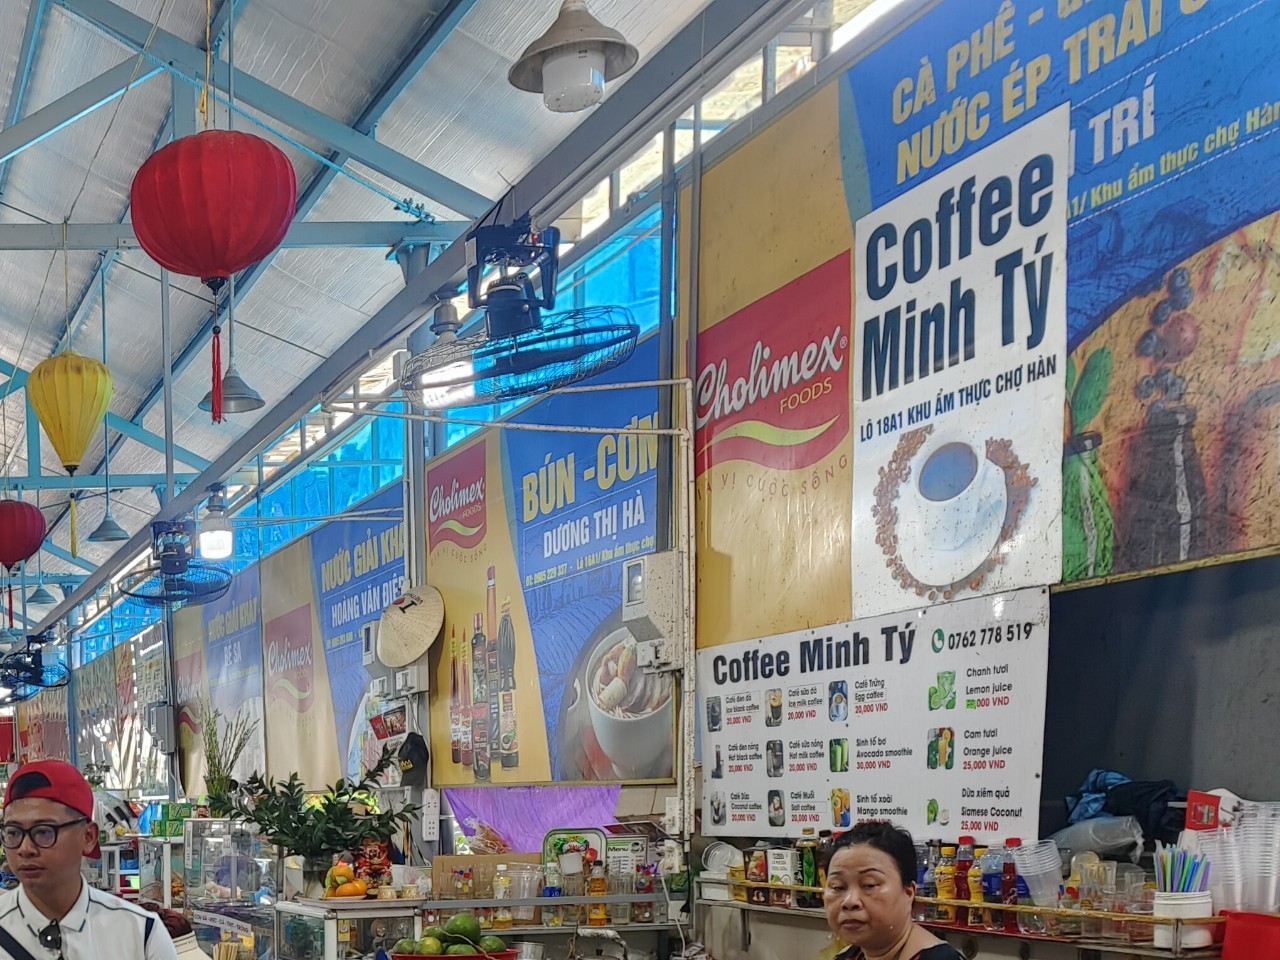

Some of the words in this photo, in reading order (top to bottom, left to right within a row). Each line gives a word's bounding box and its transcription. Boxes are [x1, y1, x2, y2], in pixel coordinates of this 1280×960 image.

[892, 57, 936, 125] CÀ
[947, 0, 1015, 93] PHÊ
[895, 91, 990, 185] NƯỚC
[1002, 54, 1051, 124] ÉP
[1089, 72, 1157, 165] TRÍ
[1091, 178, 1123, 209] Khu
[1128, 162, 1154, 190] ẩm
[1160, 142, 1199, 171] thực
[1204, 118, 1240, 153] chợ
[867, 153, 1054, 301] Coffee
[862, 277, 976, 402] Minh
[995, 233, 1054, 351] Tý
[696, 326, 844, 430] Cholimex
[779, 377, 833, 415] FOODS
[860, 419, 874, 443] LÔ
[876, 412, 904, 437] 18A1
[907, 401, 932, 425] KHU
[935, 388, 956, 417] ẨM
[958, 378, 992, 408] THỰC
[995, 364, 1024, 395] CHỢ
[1027, 354, 1057, 380] HÀN
[522, 453, 575, 522] BÚN
[430, 477, 484, 522] Cholimex
[462, 503, 481, 519] FOODS
[543, 514, 589, 558] DƯƠNG
[593, 505, 618, 540] THỊ
[622, 489, 645, 530] HÀ
[321, 548, 352, 593] NƯỚC
[354, 528, 379, 577] GIẢI
[331, 594, 360, 628] HOÀNG
[361, 585, 380, 616] VĂN
[269, 637, 312, 676] Cholimex
[713, 649, 790, 685] Coffee
[800, 632, 870, 674] Minh
[881, 621, 916, 665] Tý
[948, 628, 976, 650] 0762
[980, 625, 1002, 645] 778
[1007, 622, 1032, 642] 519
[966, 667, 991, 678] Chanh
[993, 664, 1009, 674] tươi
[966, 684, 990, 695] Lemon
[992, 682, 1013, 696] juice
[855, 692, 864, 703] Egg
[992, 696, 1009, 706] VND
[875, 702, 888, 712] VND
[805, 710, 816, 719] VND
[964, 730, 981, 739] Cam
[983, 728, 998, 738] tươi
[856, 738, 868, 746] Sinh
[798, 751, 809, 759] milk
[809, 750, 824, 758] coffee
[856, 749, 884, 758] Avocado
[885, 747, 913, 756] smoothie
[963, 747, 990, 757] Orange
[992, 745, 1013, 757] juice
[806, 763, 817, 771] VND
[878, 760, 890, 769] VND
[963, 760, 986, 771] 25,000
[988, 760, 1005, 769] VND
[857, 795, 868, 803] Sinh
[878, 794, 892, 803] xoài
[962, 788, 975, 798] Dừa
[976, 788, 993, 798] xiêm
[995, 786, 1010, 799] quả
[801, 803, 816, 811] coffee
[857, 807, 878, 816] Mango
[880, 806, 907, 816] smoothie
[961, 806, 988, 816] Siamese
[990, 806, 1023, 817] Coconut
[808, 814, 820, 822] VND
[961, 820, 982, 831] 25,000
[983, 821, 999, 831] VND
